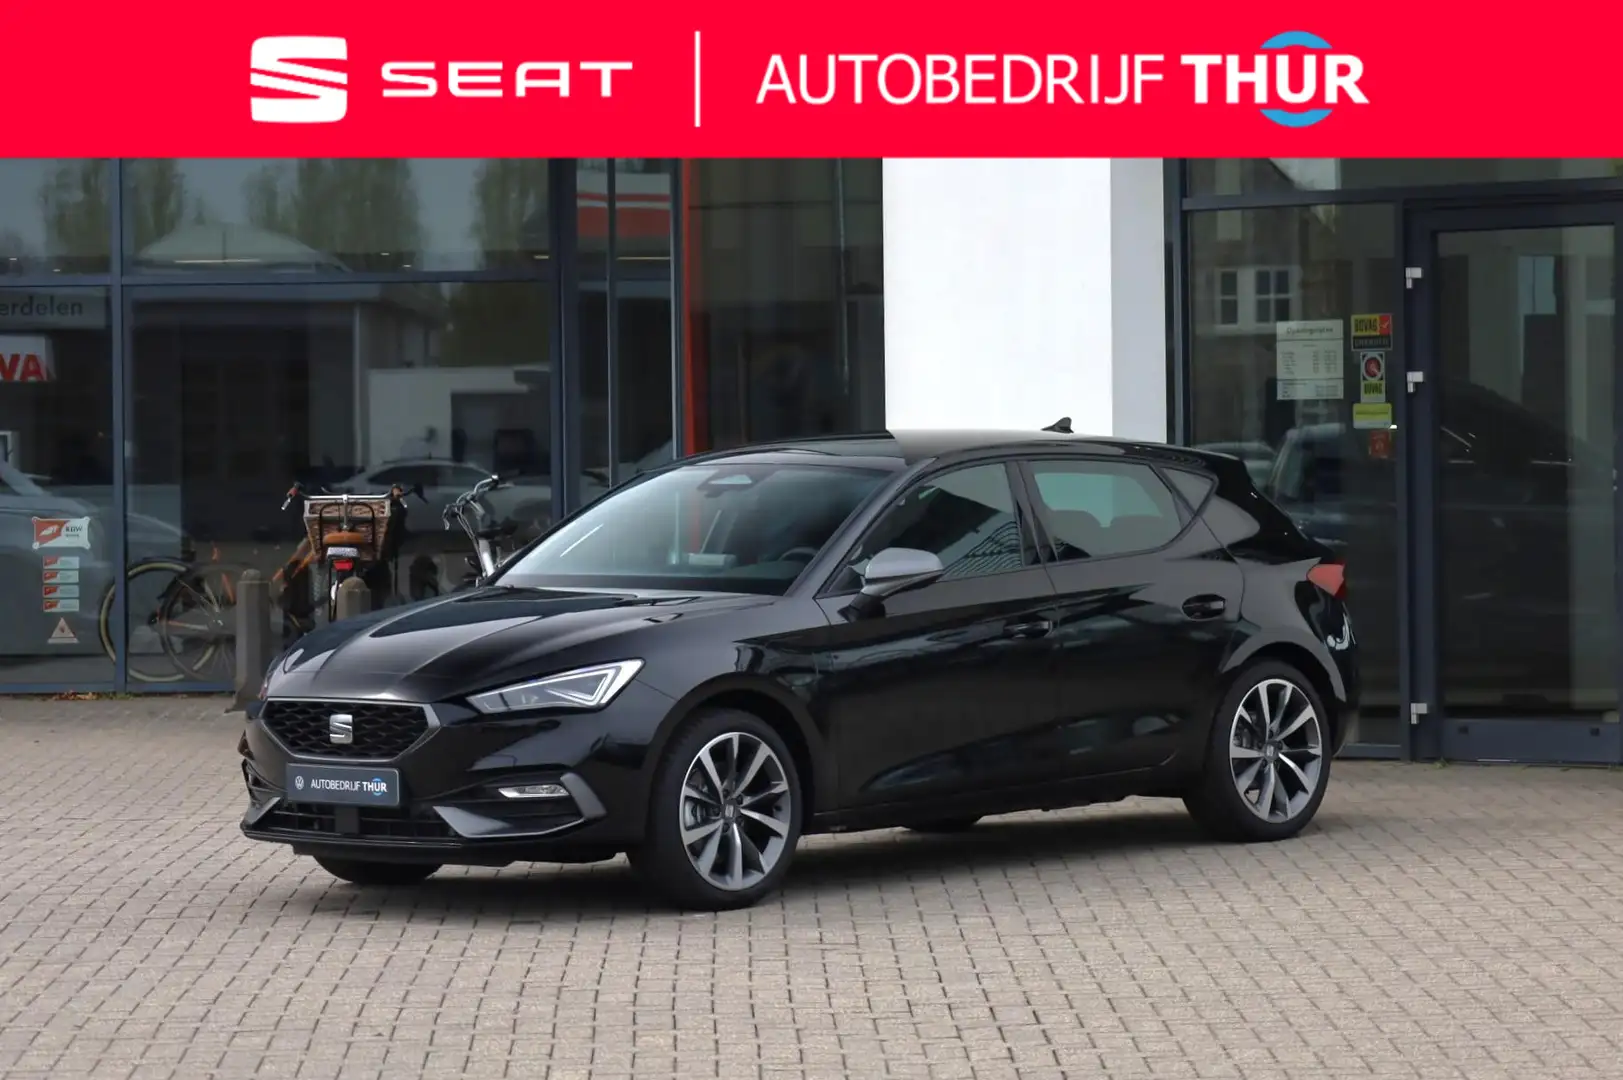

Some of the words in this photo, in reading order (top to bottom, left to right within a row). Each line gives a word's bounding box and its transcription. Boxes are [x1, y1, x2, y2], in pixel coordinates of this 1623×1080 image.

[0, 295, 83, 316] erdelen
[1354, 318, 1378, 332] BOVAG
[310, 778, 361, 792] AUTOBEDRIJF
